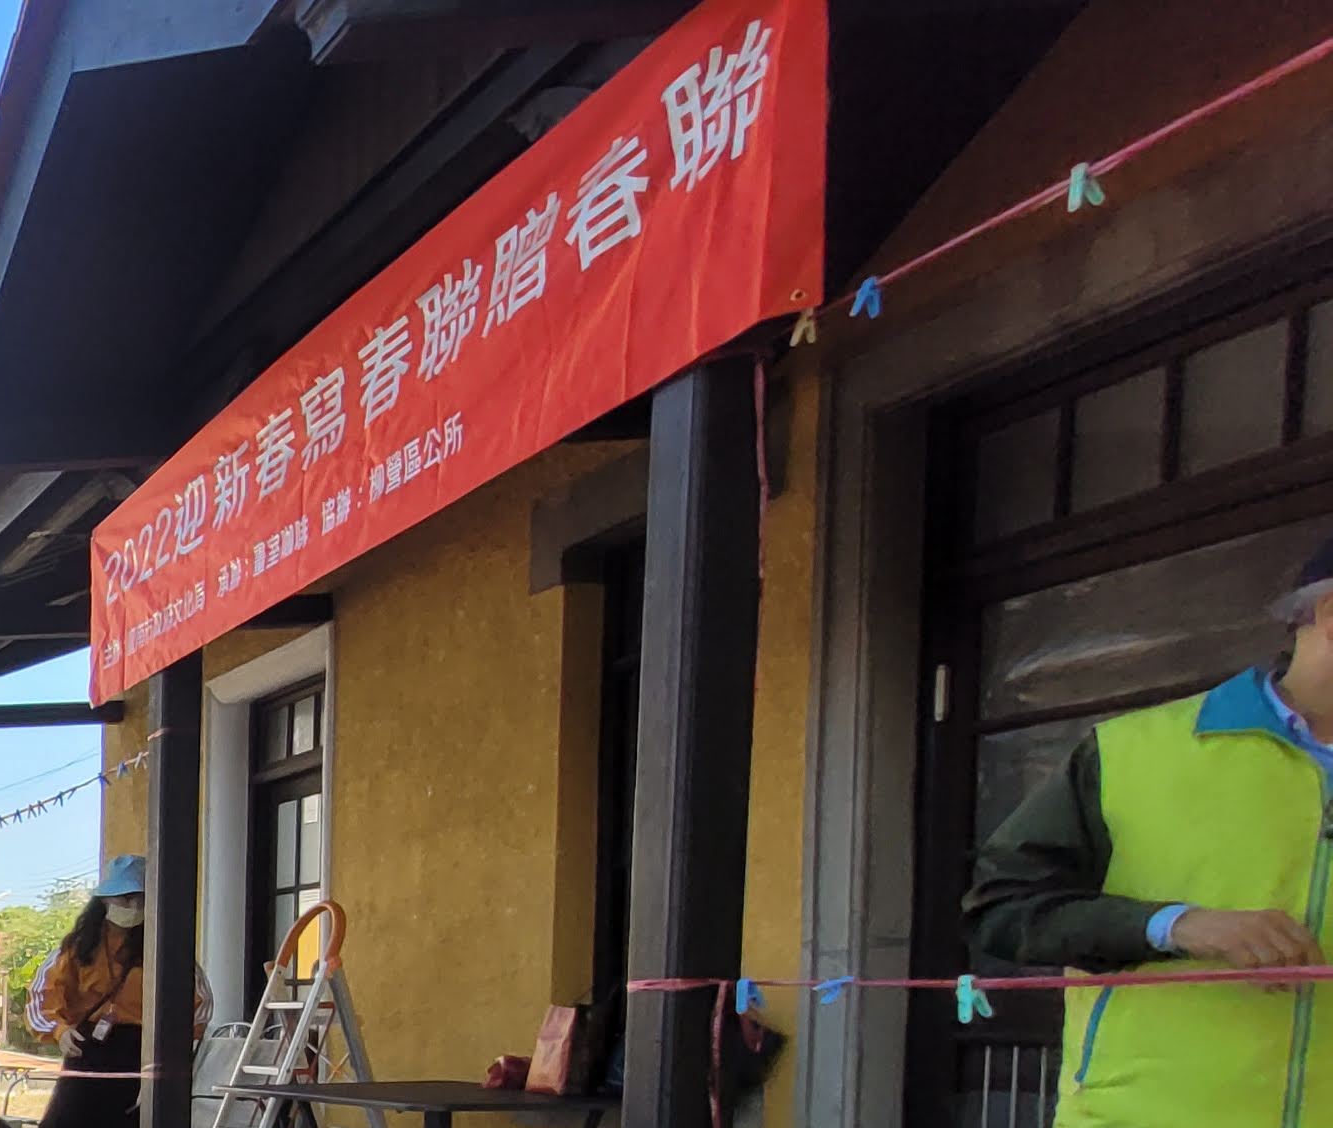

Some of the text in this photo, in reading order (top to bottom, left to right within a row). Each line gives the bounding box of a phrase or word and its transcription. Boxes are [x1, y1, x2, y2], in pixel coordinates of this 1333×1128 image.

[103, 19, 774, 605] 2022迎新春寫春聯贈春聯
